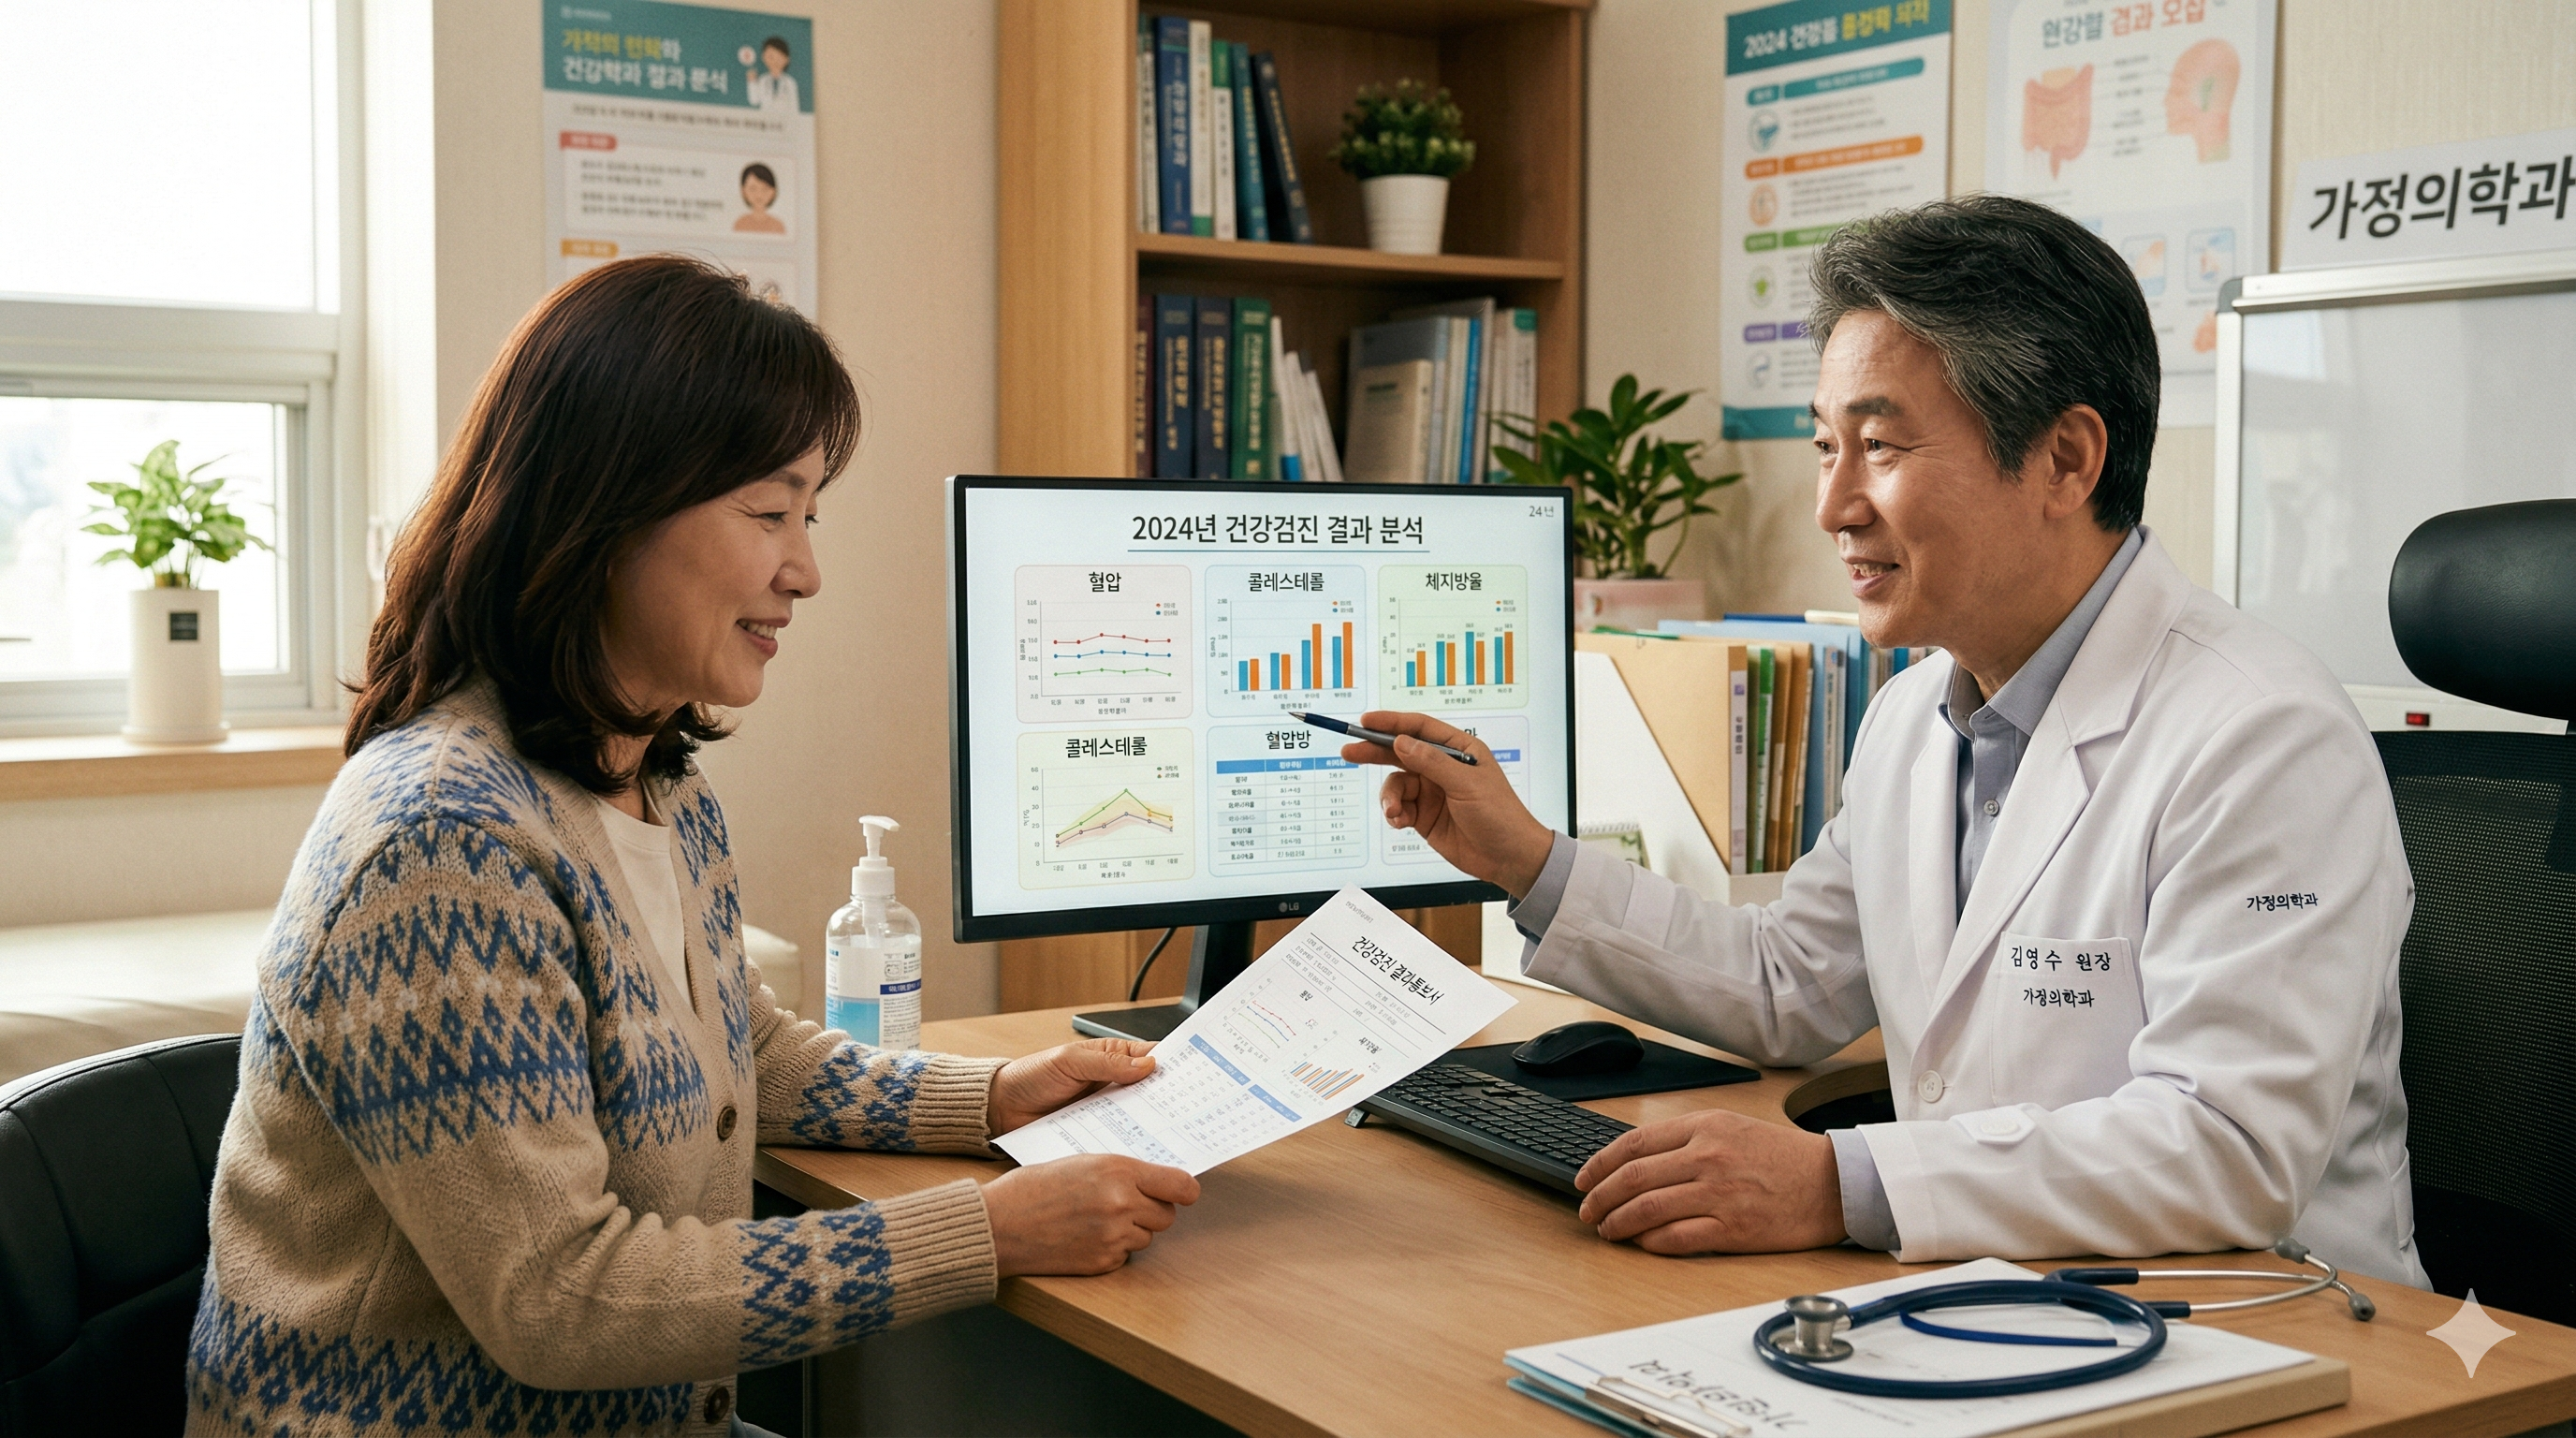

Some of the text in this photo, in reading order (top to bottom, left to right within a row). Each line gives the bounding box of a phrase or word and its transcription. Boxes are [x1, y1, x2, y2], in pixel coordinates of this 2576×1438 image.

[2309, 154, 2576, 240] 가정의학과
[1133, 514, 1423, 545] 2024년 건강검진 결과 분석
[1089, 571, 1121, 593] 혈압
[1426, 571, 1483, 591] 체지방율
[1288, 902, 1300, 911] LG
[2247, 892, 2319, 912] 가정의학과
[2075, 951, 2112, 972] 원장
[2023, 987, 2095, 1008] 가정의학과
